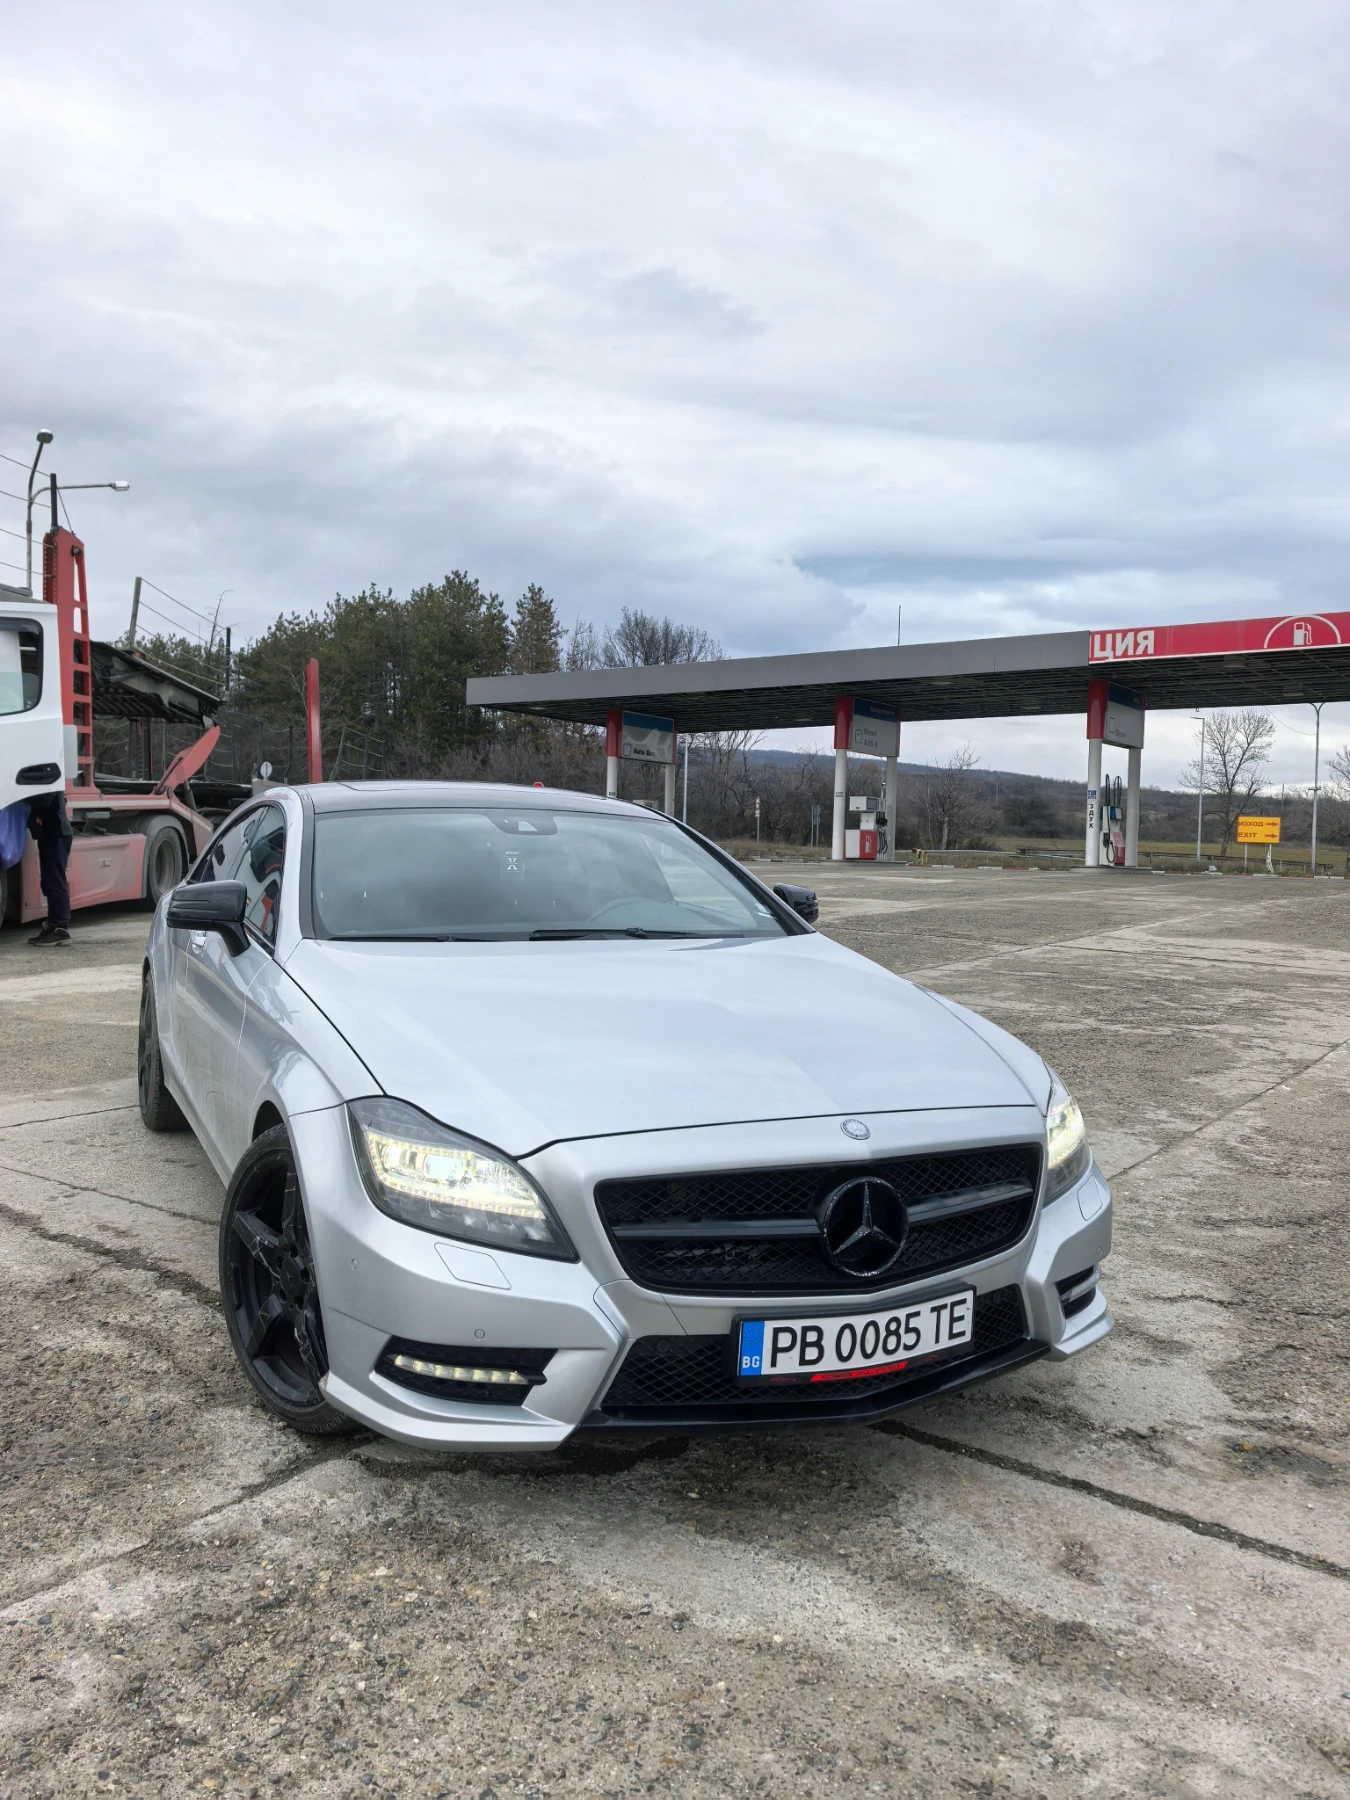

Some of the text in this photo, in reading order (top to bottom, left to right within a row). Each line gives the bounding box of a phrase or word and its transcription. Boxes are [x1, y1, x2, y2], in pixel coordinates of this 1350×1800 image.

[1089, 630, 1154, 661] ЦИЯ
[633, 747, 645, 756] Auto
[770, 1298, 967, 1368] PB 0085 TE
[742, 1355, 760, 1369] BG
